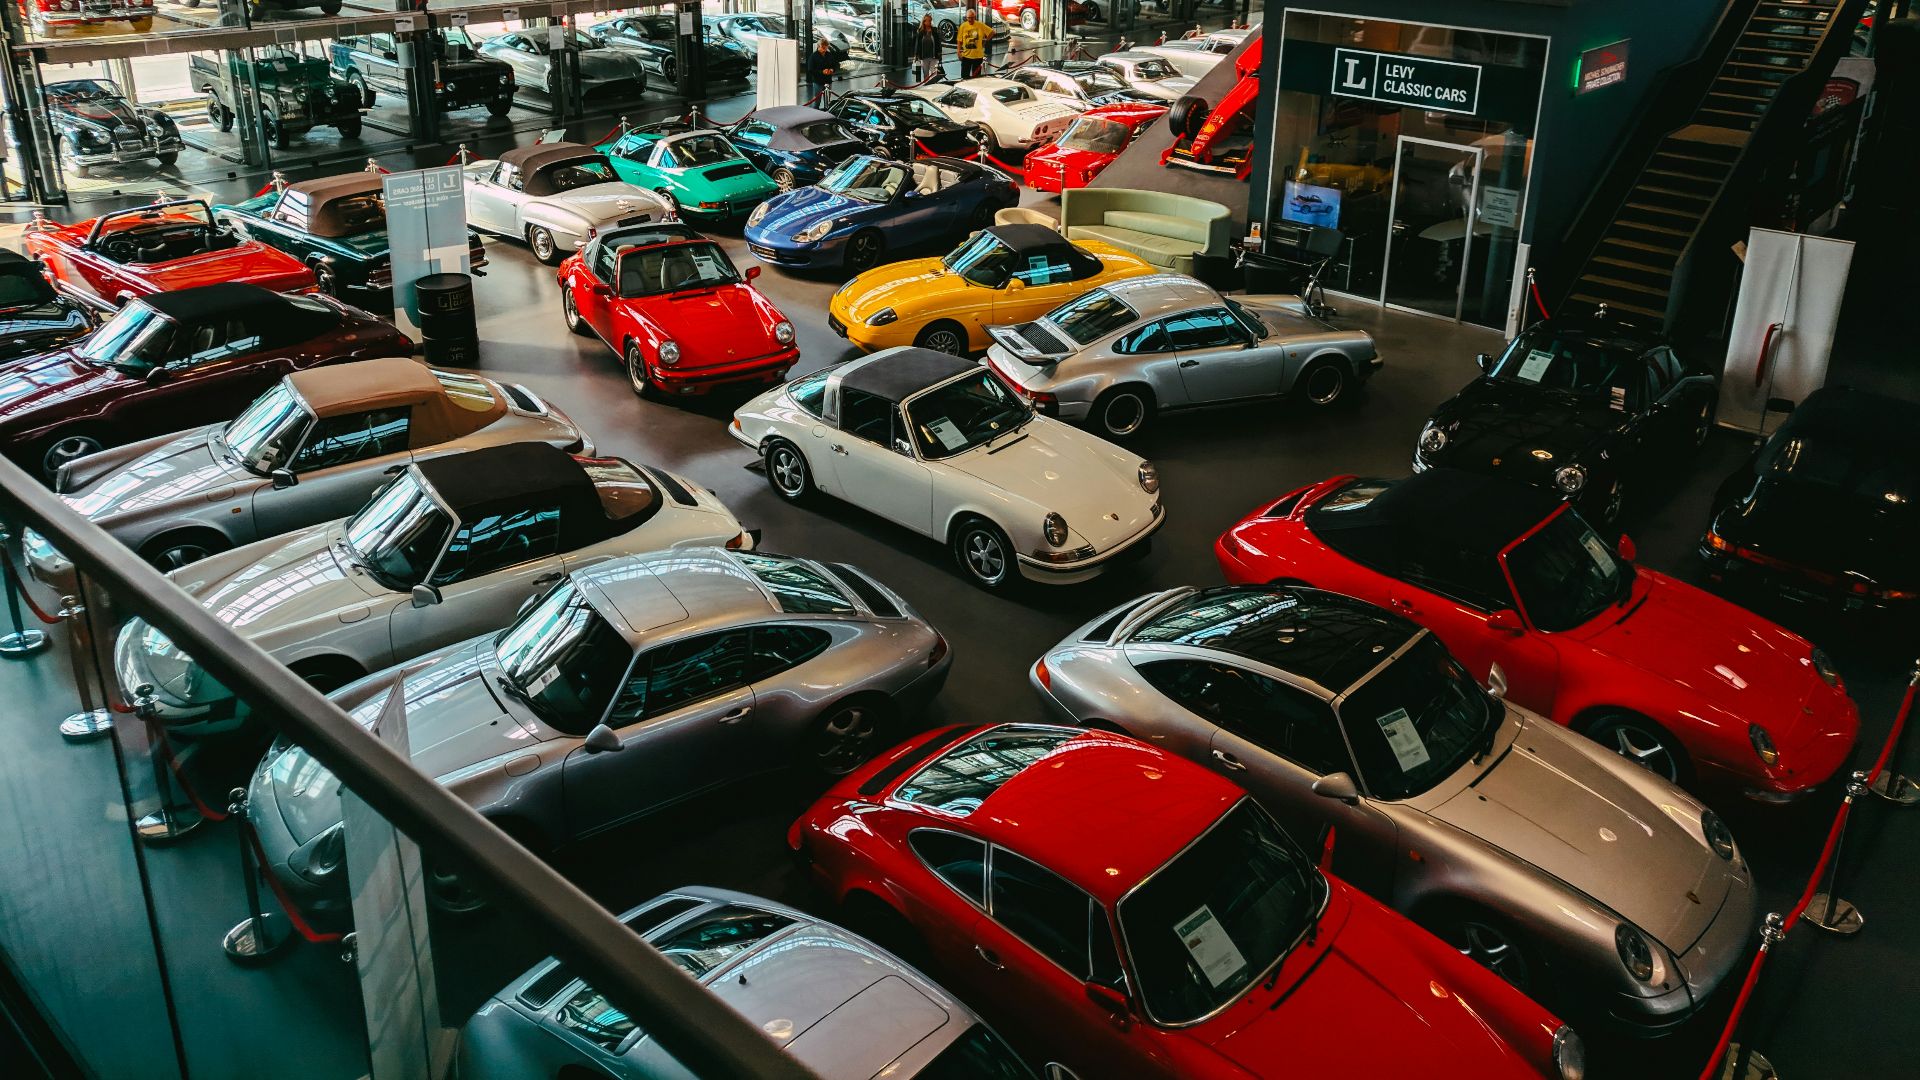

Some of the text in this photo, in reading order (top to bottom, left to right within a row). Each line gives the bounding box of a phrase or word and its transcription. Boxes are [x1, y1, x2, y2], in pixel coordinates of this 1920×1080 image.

[1342, 58, 1366, 89] L
[1385, 63, 1415, 79] LEVY
[1383, 79, 1467, 103] CLASSIC CARS
